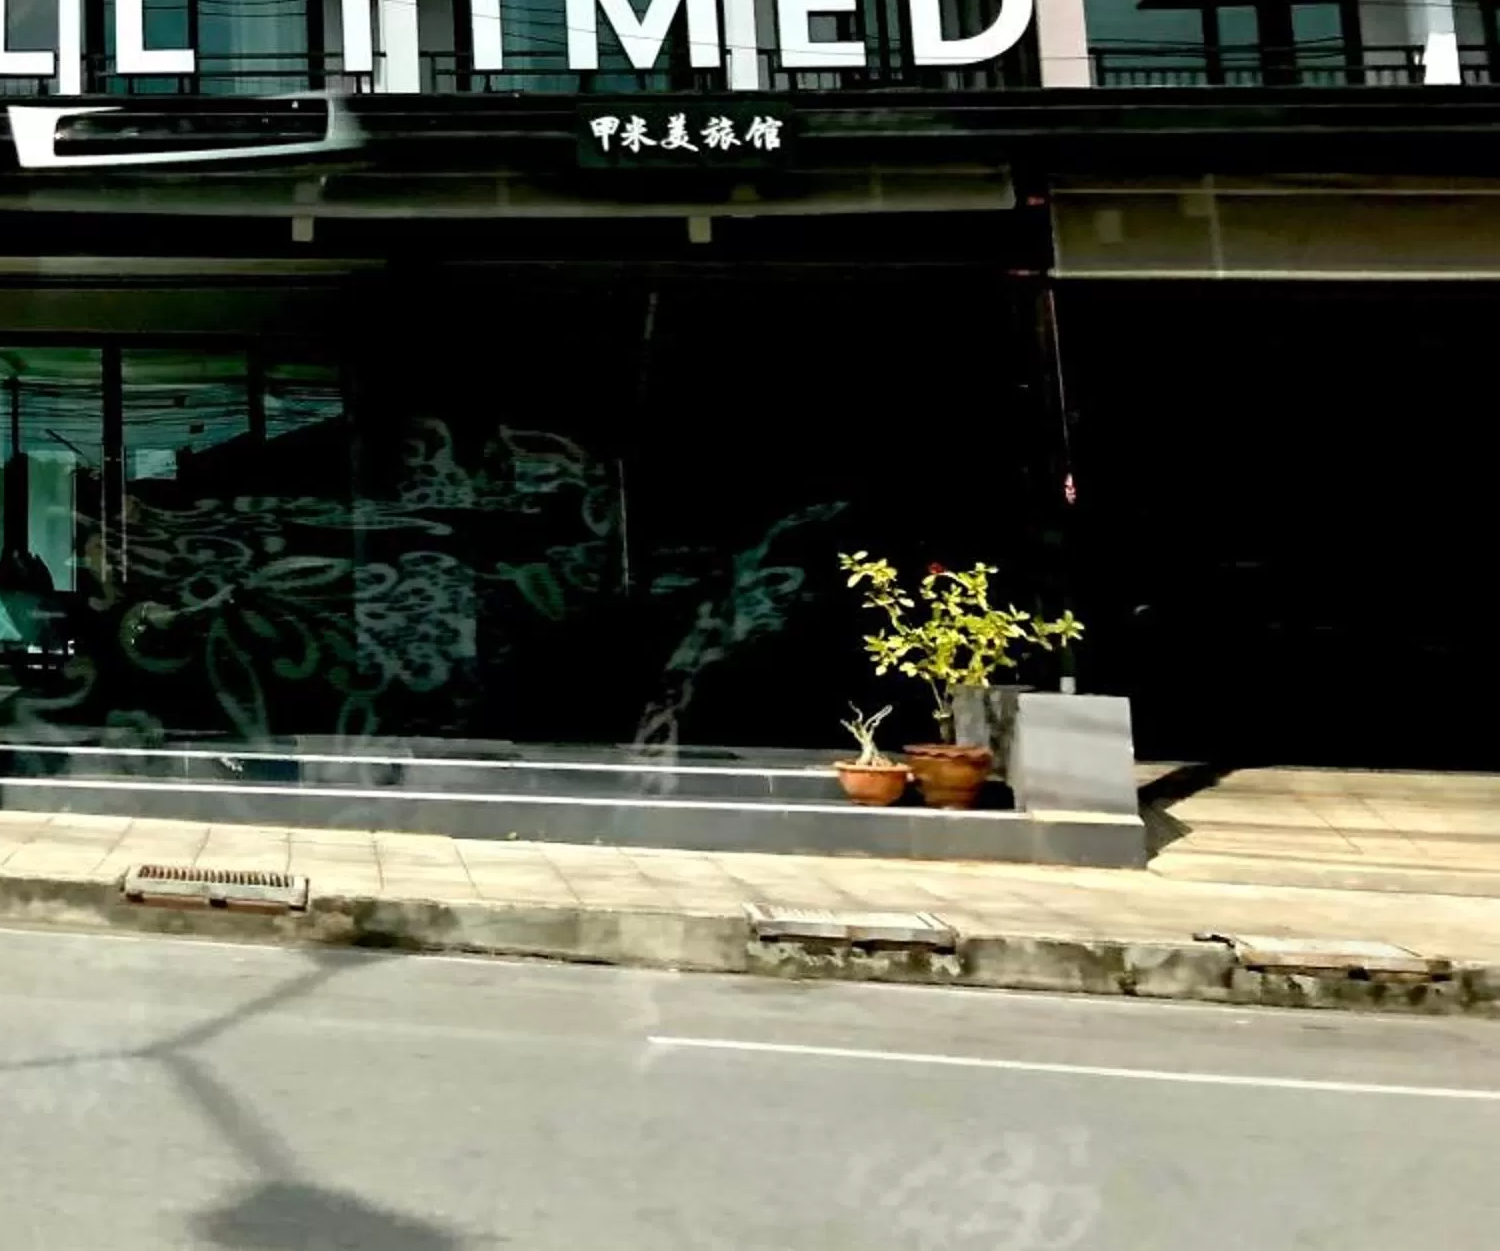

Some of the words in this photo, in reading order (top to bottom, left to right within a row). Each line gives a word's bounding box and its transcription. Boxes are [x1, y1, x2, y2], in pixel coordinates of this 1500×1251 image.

[589, 111, 784, 154] 甲米美旅馆
